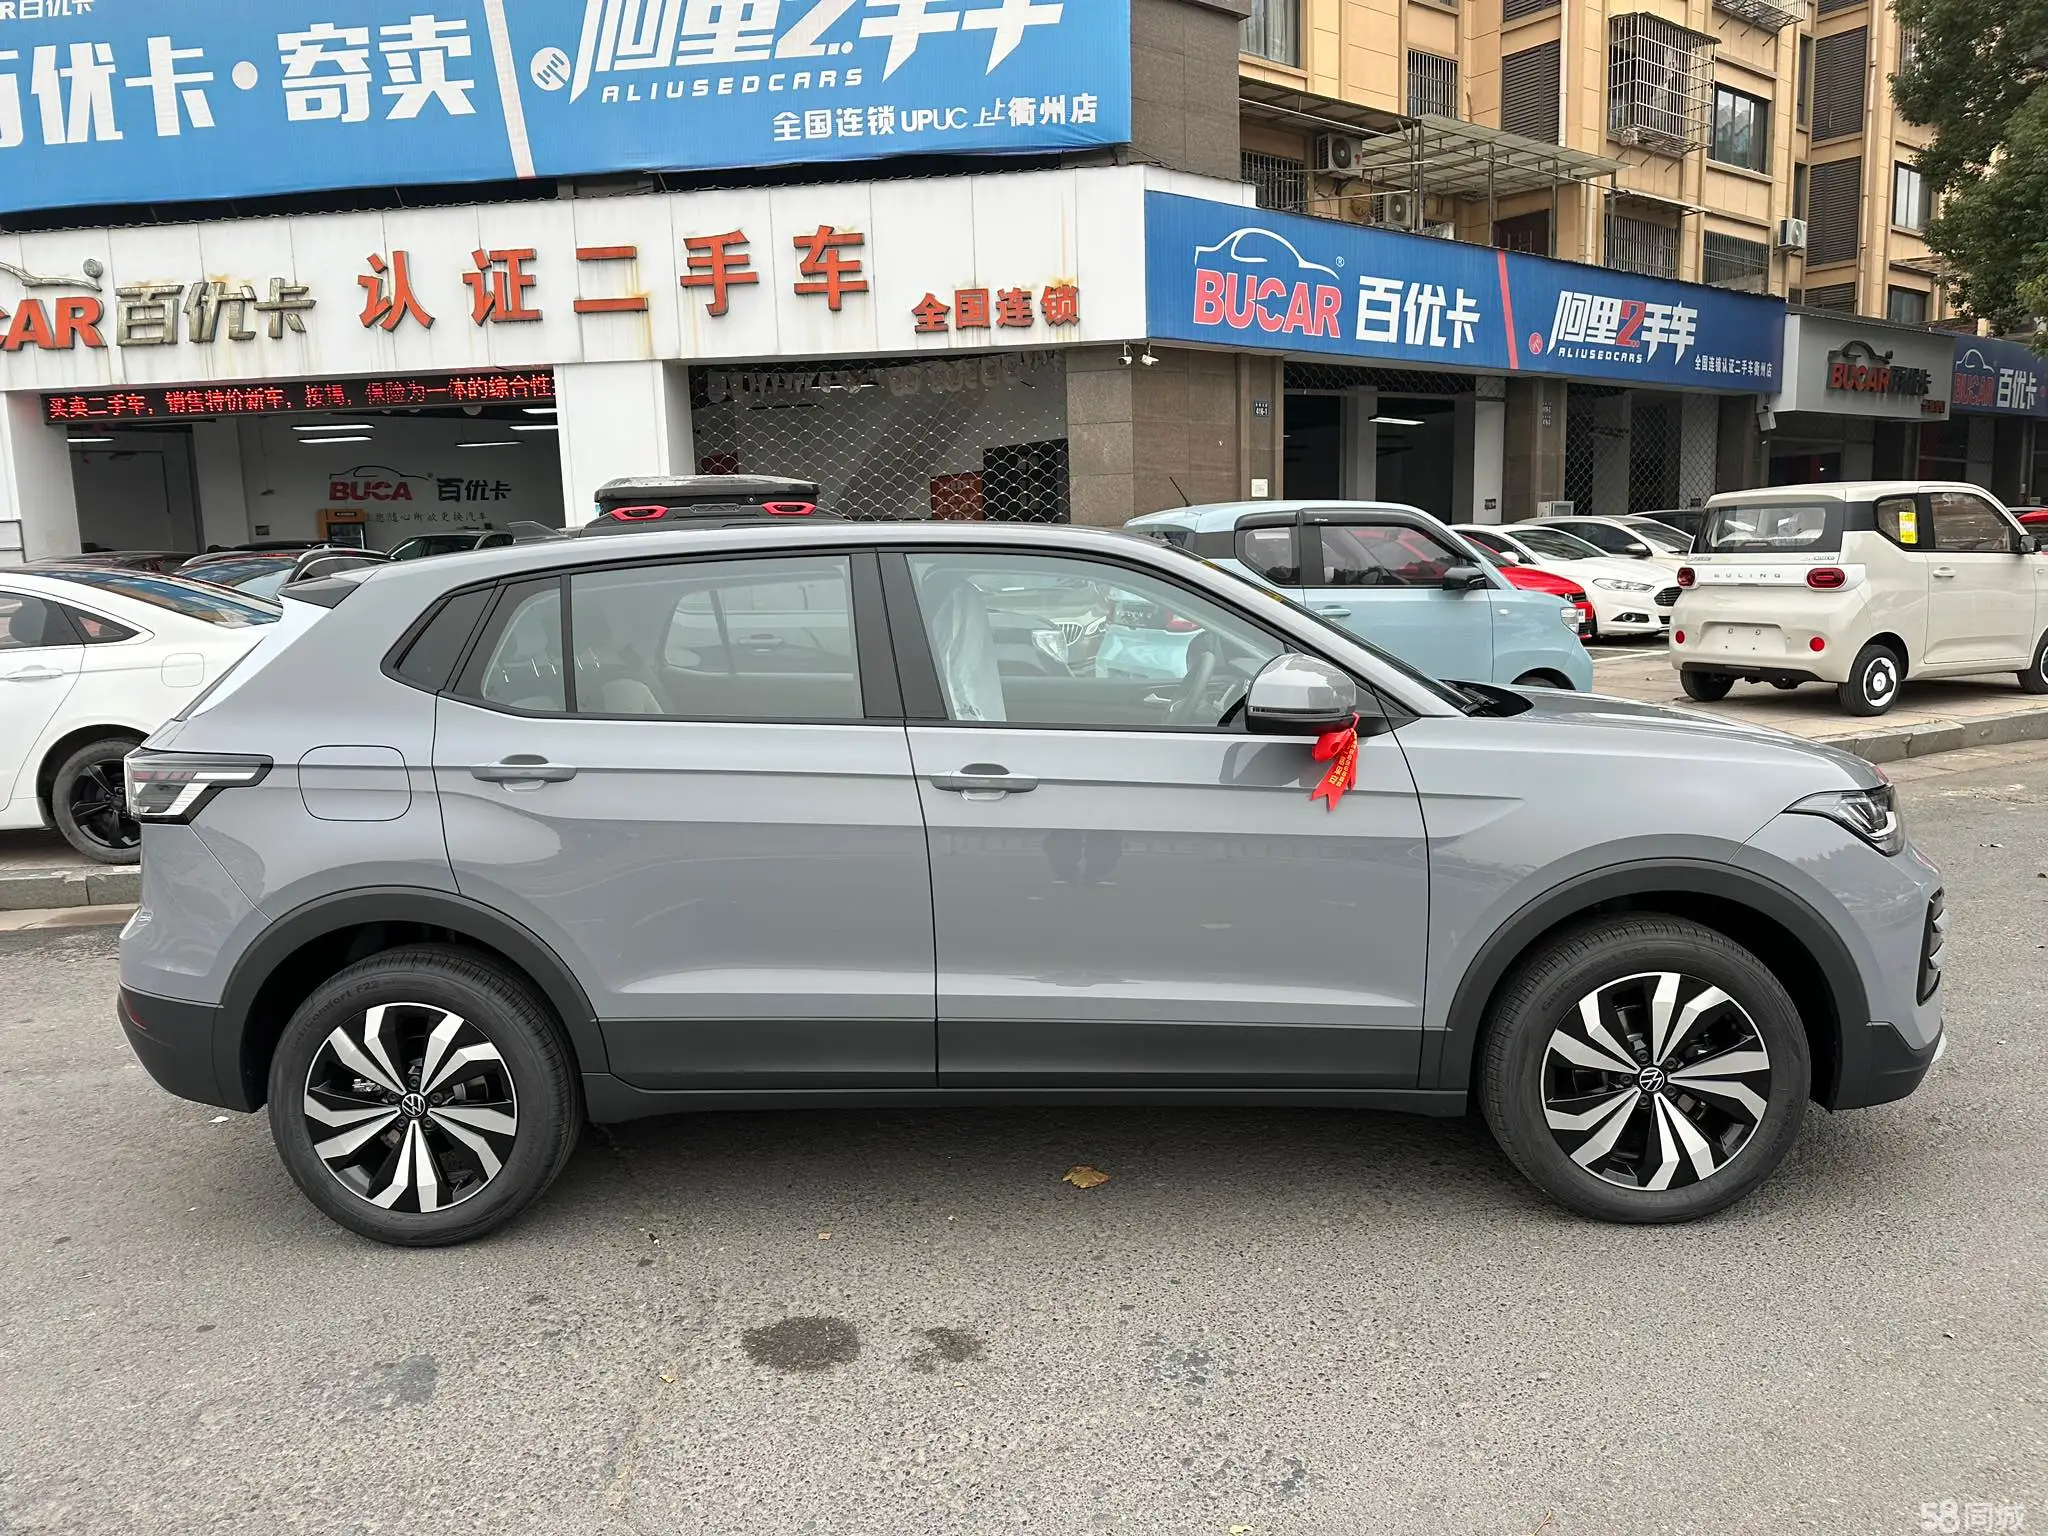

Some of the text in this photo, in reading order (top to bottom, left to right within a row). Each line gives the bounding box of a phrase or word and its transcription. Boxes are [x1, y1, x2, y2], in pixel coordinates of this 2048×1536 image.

[601, 68, 864, 104] ALIUSEDCARS
[357, 224, 869, 332] 认证二手车
[0, 277, 317, 351] AR 百优卡
[911, 283, 1081, 335] 全国连锁
[1193, 268, 1480, 349] BUCAR 百优卡
[1558, 347, 1644, 364] ALIUSEDCARS
[1996, 368, 2038, 410] 百优卡
[436, 477, 512, 502] 百优卡
